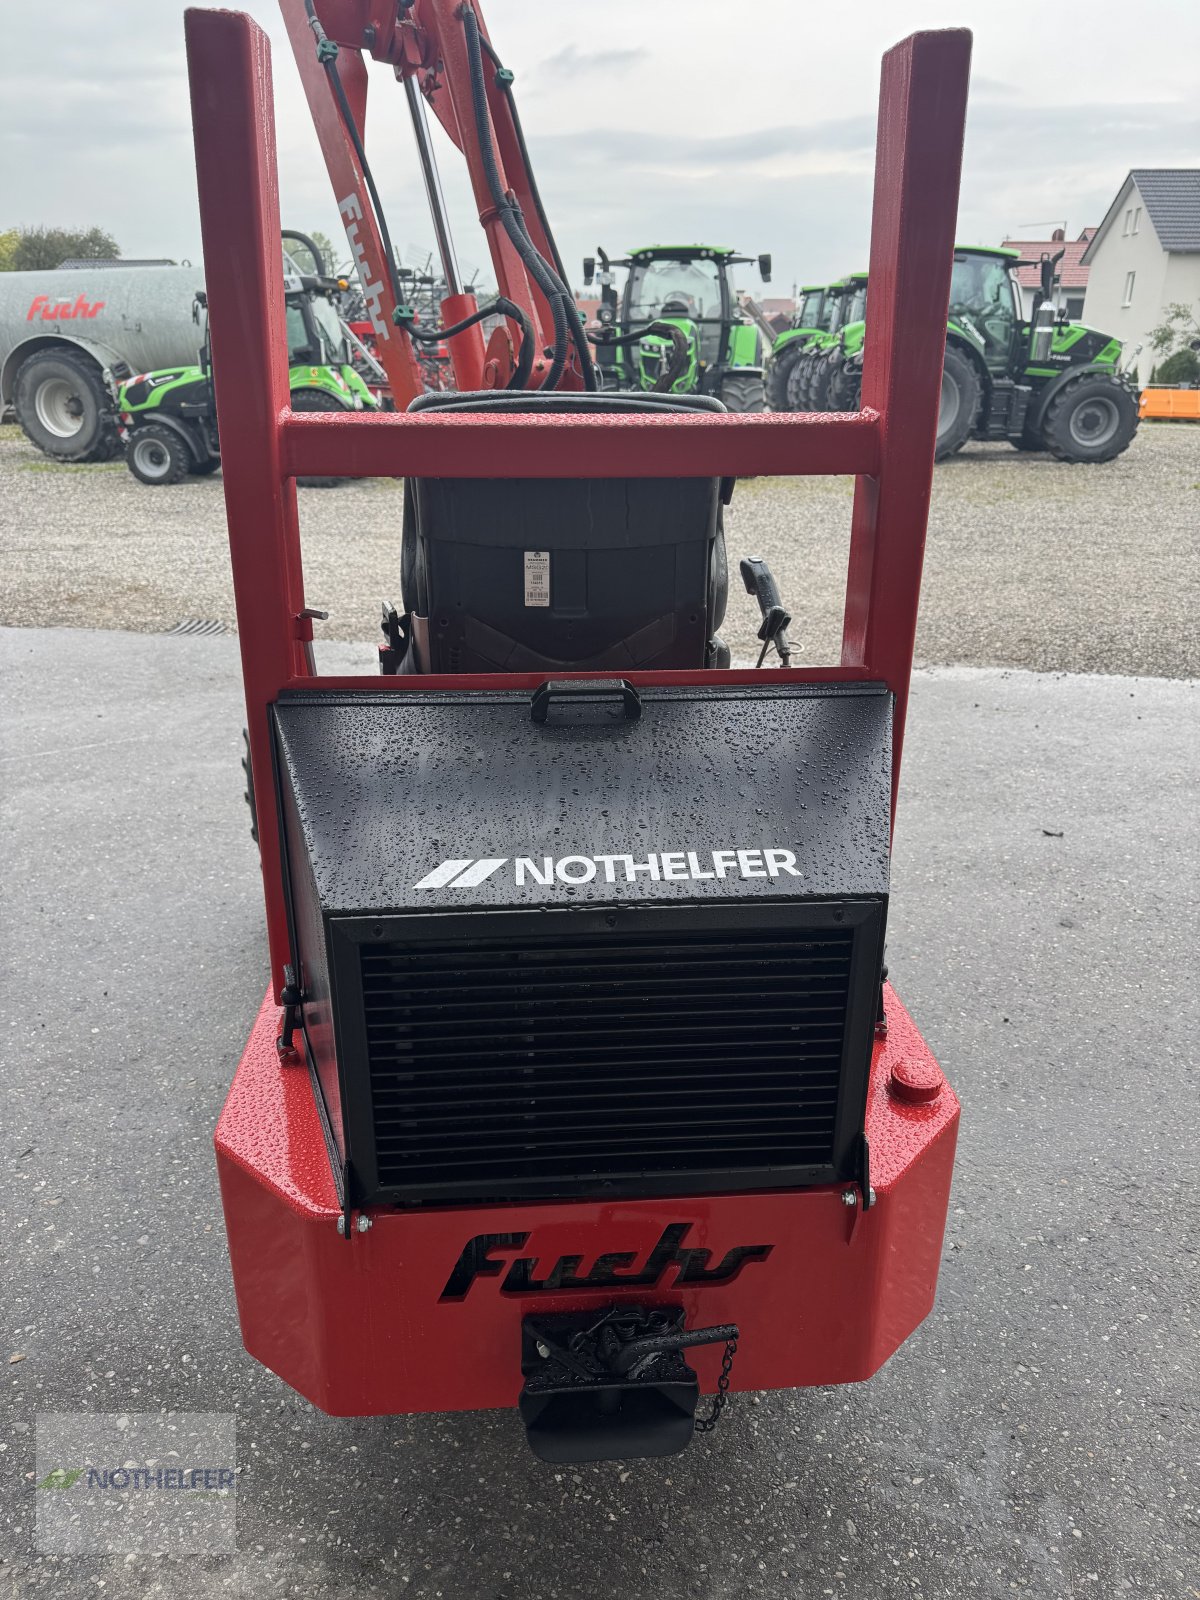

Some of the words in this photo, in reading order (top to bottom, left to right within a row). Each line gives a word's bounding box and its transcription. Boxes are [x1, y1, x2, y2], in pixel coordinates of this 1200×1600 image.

[338, 192, 390, 341] Fuchs
[26, 292, 106, 321] Fuchs
[515, 848, 803, 886] NOTHELFER
[437, 1222, 776, 1304] Fuchs
